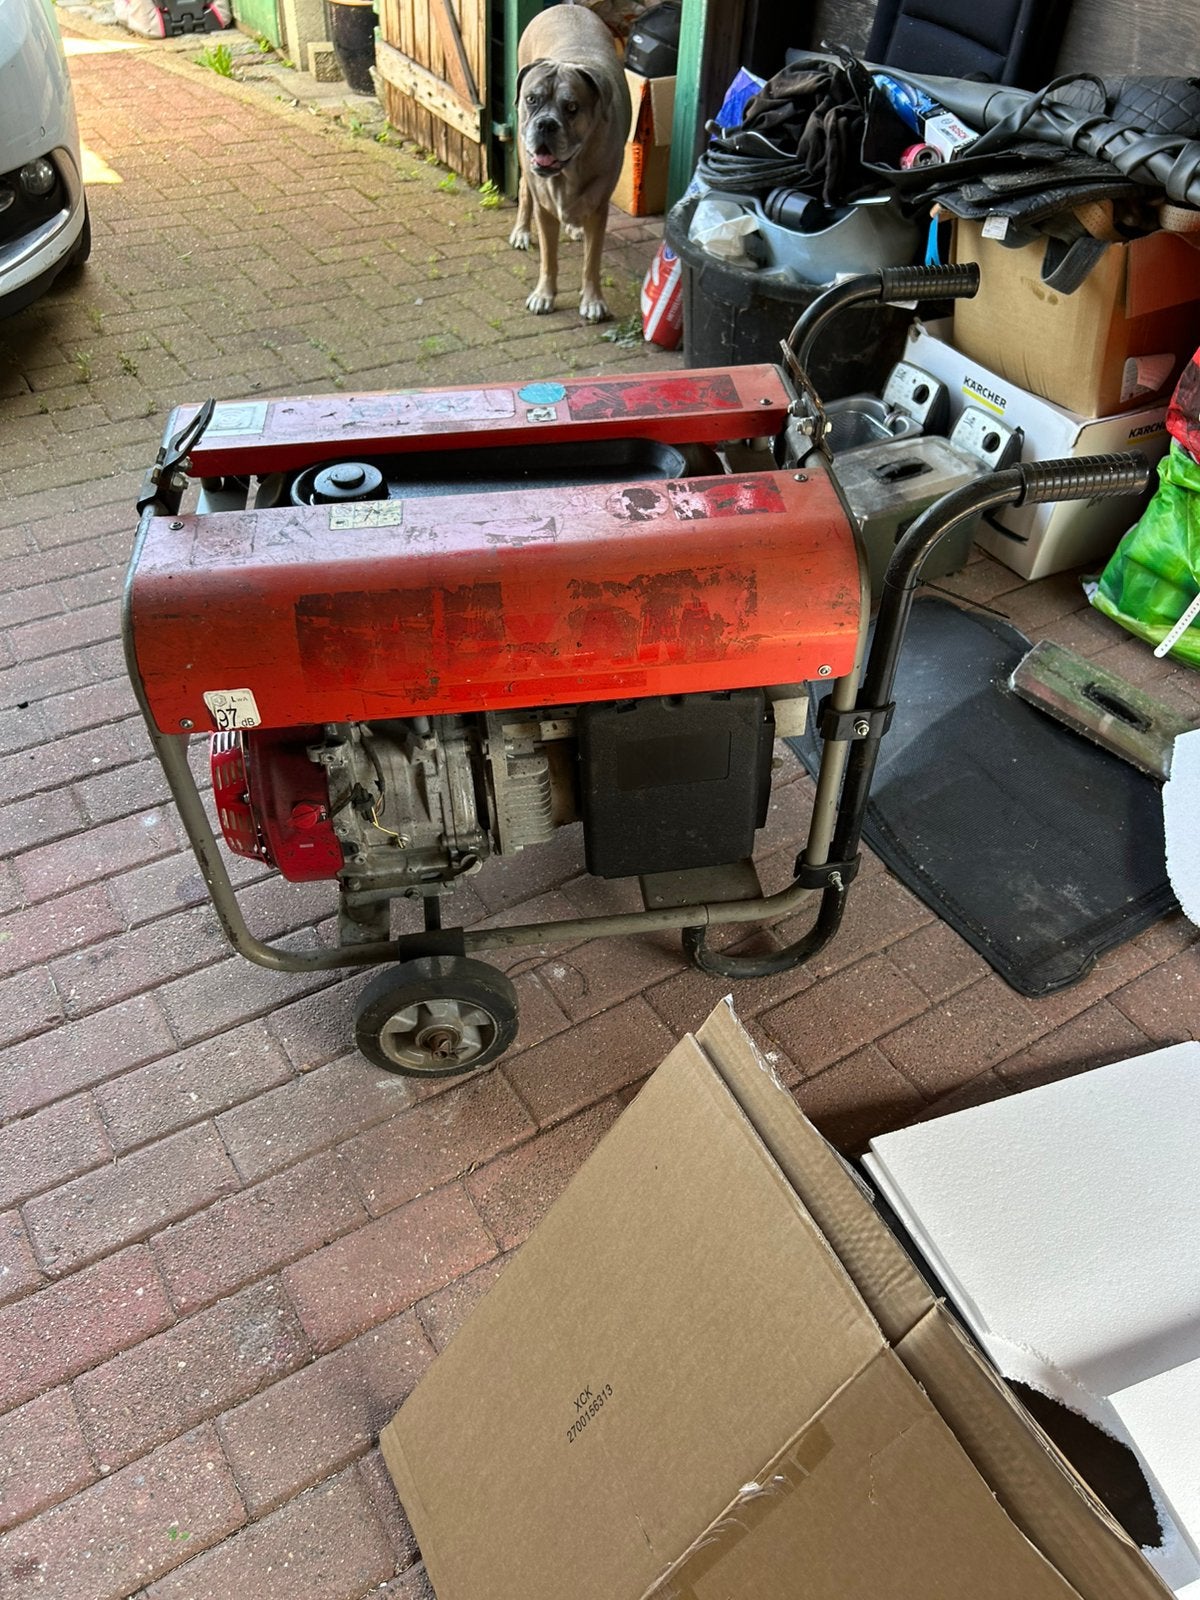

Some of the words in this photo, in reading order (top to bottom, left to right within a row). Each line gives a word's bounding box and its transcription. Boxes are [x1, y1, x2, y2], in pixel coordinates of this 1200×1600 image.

[216, 707, 237, 728] 97
[241, 717, 256, 727] dB
[566, 1383, 613, 1443] 2700156313
[573, 1384, 593, 1413] XCK
